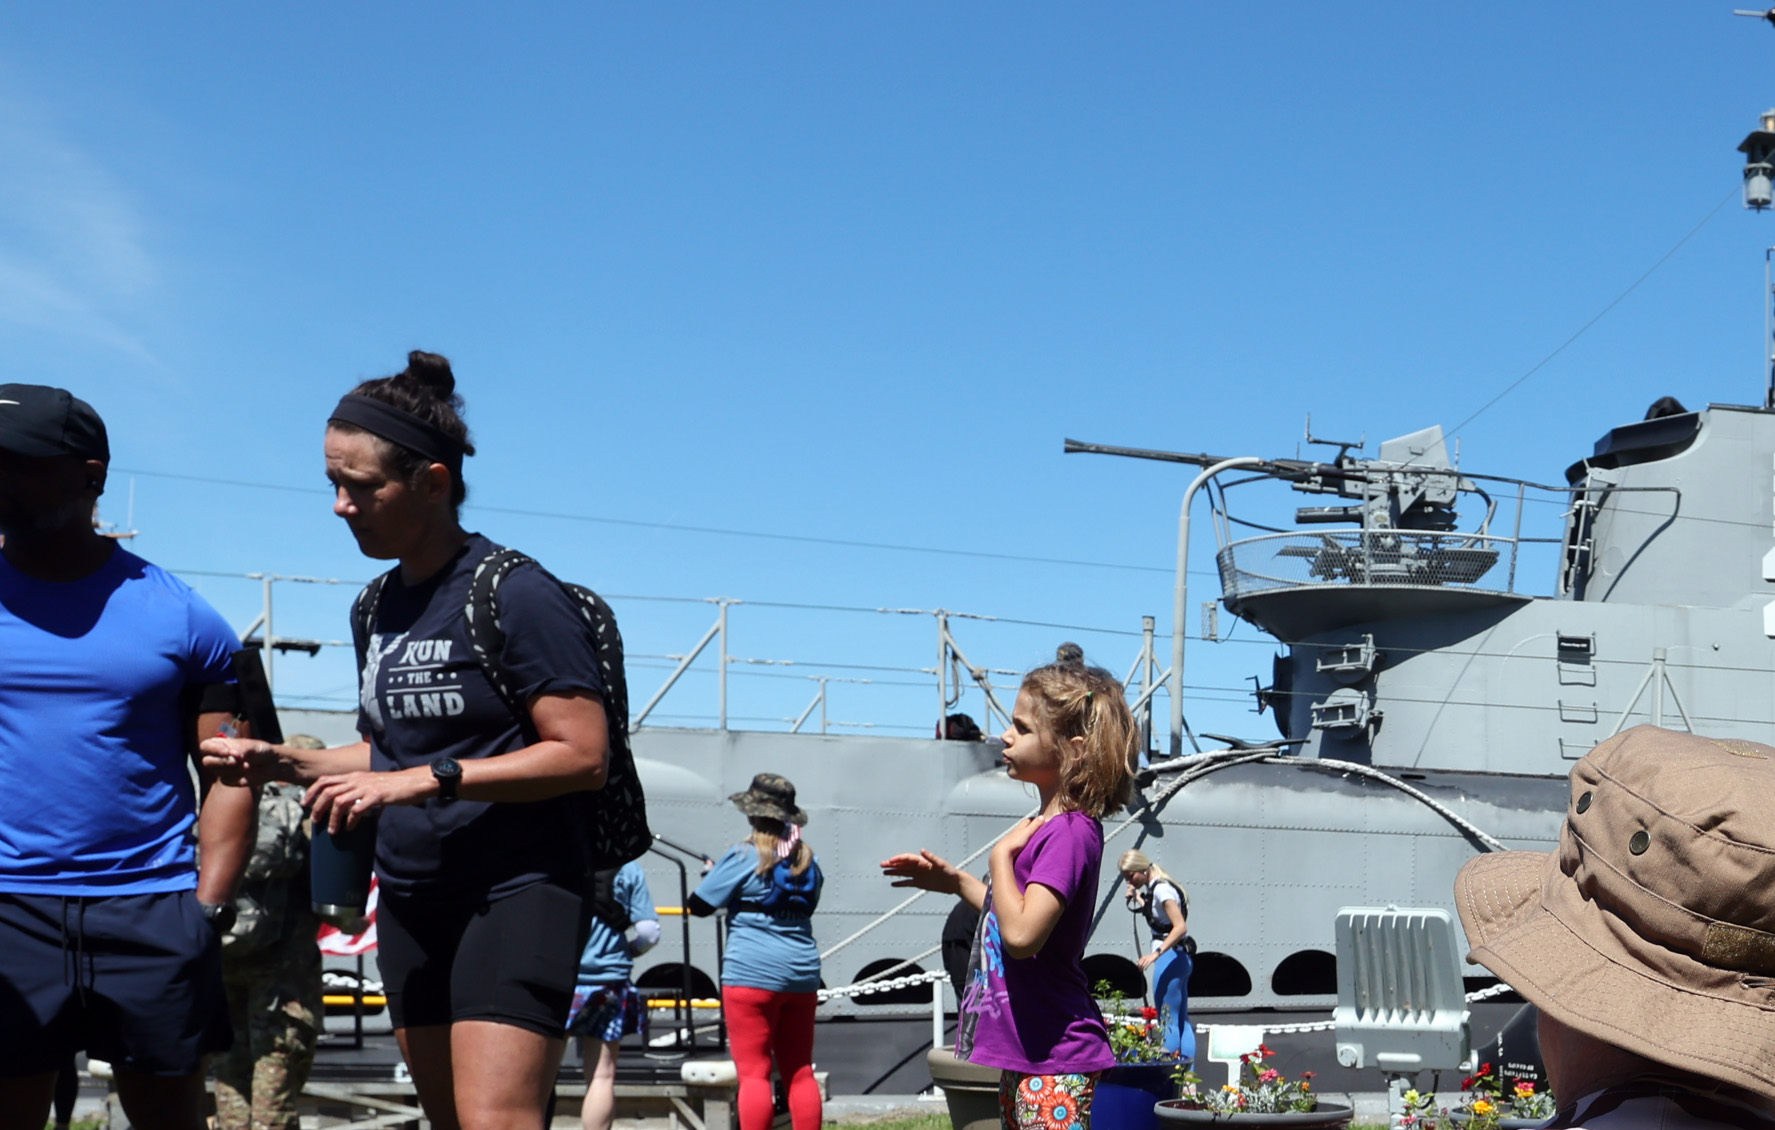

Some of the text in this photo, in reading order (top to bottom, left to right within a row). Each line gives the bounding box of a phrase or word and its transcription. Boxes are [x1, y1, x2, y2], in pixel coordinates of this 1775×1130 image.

[398, 639, 453, 666] RUN
[407, 672, 431, 684] THE
[386, 692, 464, 718] LAND
